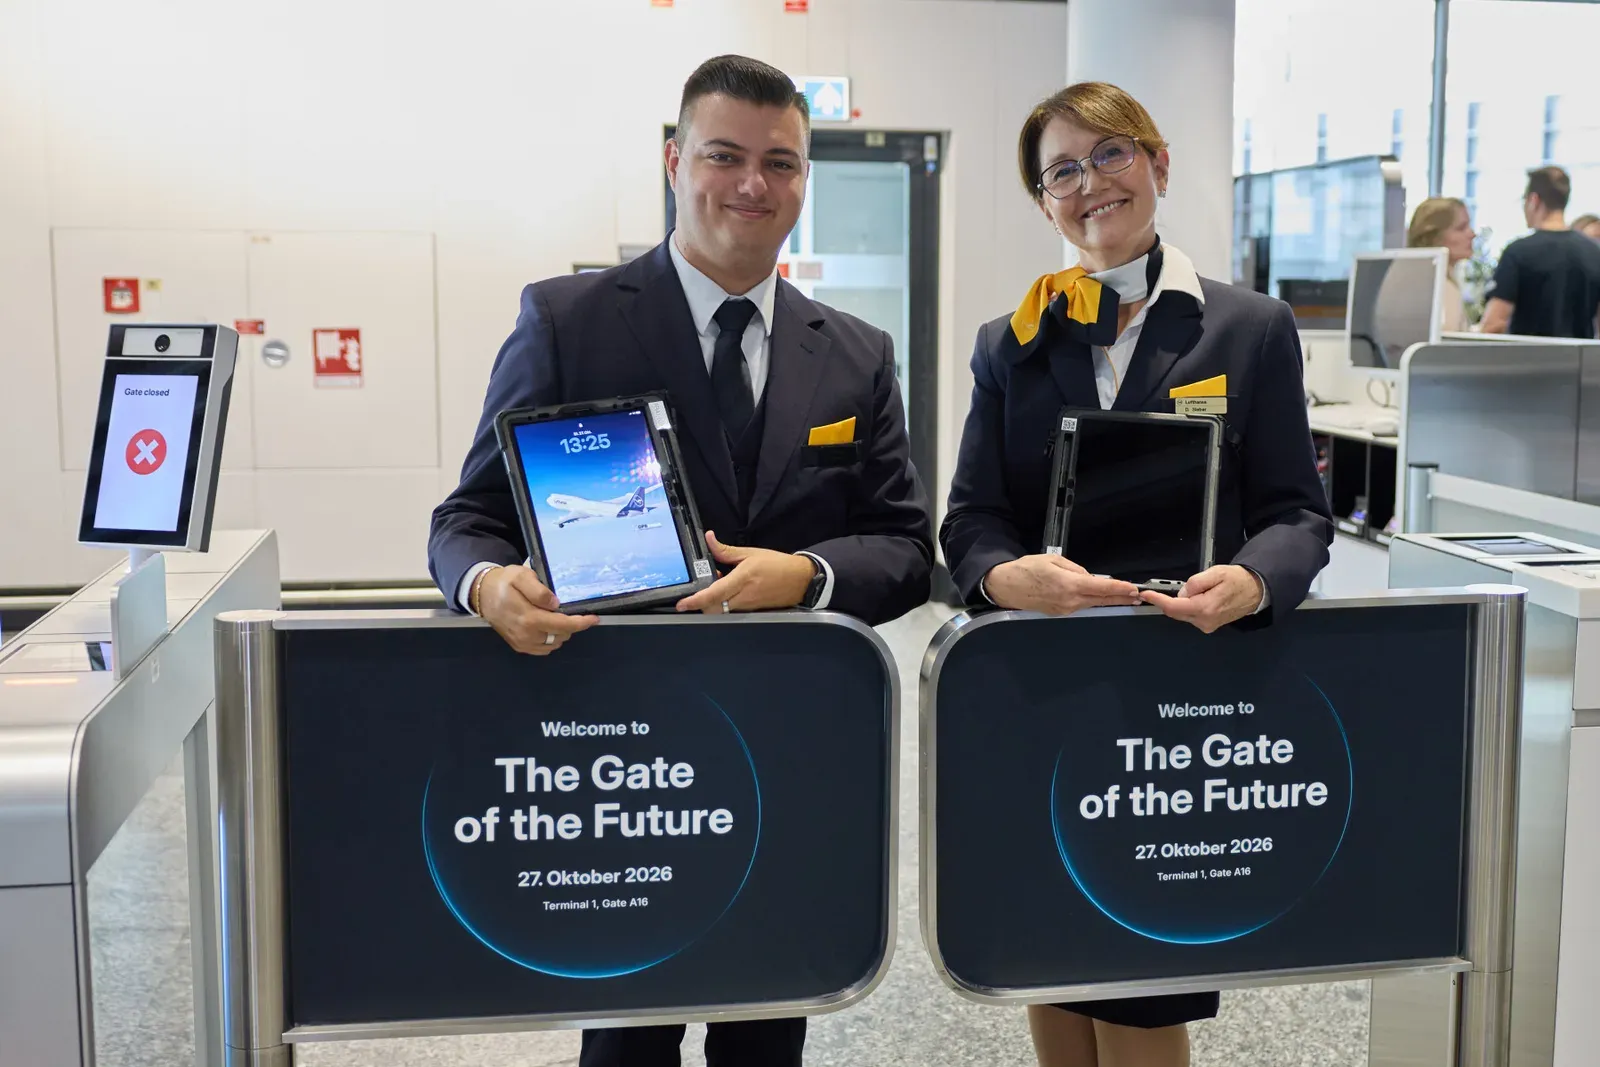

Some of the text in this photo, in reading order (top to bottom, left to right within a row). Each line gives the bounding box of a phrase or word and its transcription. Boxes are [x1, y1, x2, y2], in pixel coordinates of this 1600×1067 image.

[124, 388, 169, 397] Gate closed
[559, 433, 611, 454] 13:25
[1157, 701, 1255, 718] Welcome to
[540, 720, 650, 737] Welcome to
[1116, 733, 1294, 772] The Gate
[494, 754, 695, 793] The Gate
[1079, 778, 1328, 820] of the Future
[454, 802, 734, 843] of the Future
[1135, 836, 1273, 860] 27. Oktober 2026
[517, 865, 673, 887] 27. Oktober 2026
[1156, 866, 1251, 881] Terminal 1, Gate A16
[542, 897, 649, 911] Terminal 1, Gate A16
